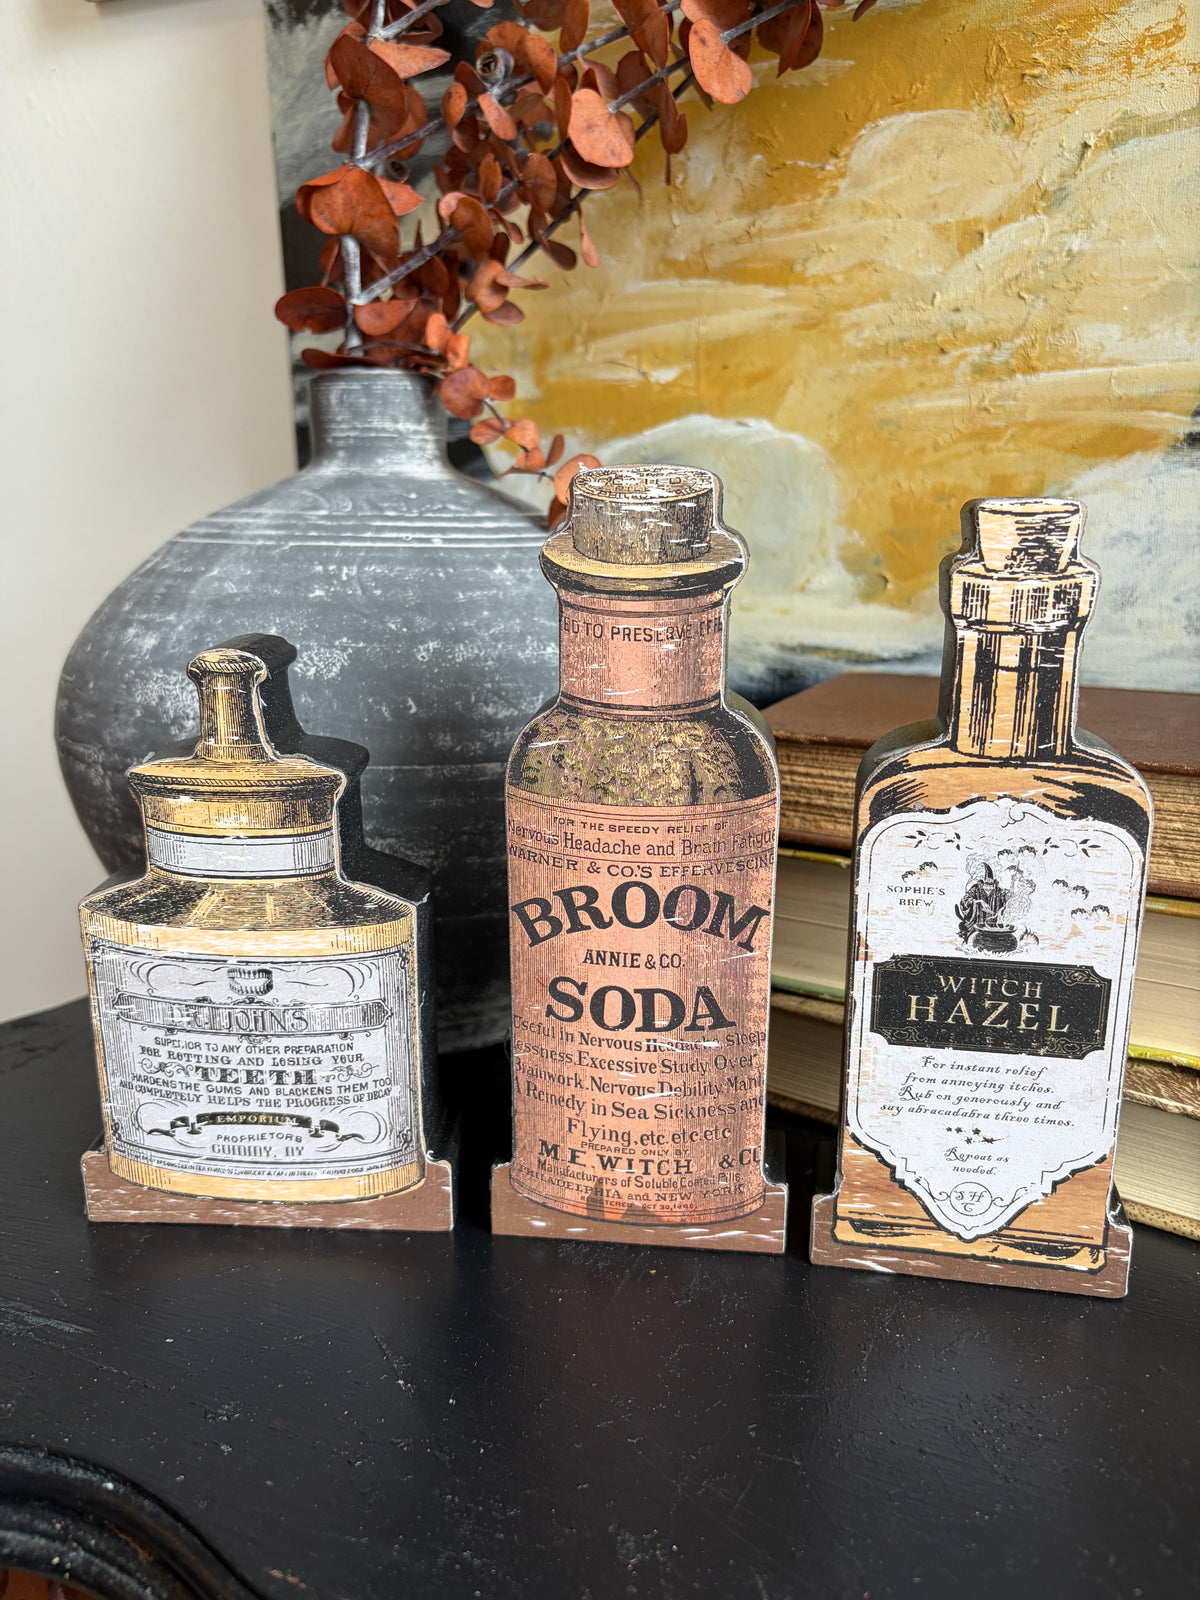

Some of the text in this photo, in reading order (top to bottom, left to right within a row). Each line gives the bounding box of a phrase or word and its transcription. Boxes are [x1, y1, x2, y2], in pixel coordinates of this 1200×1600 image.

[582, 622, 603, 639] TO
[611, 624, 693, 642] PRESERVE
[553, 817, 728, 834] FOR THE SPEEDY RELIEF OF
[507, 819, 559, 845] Nervous
[563, 831, 640, 856] Headache
[646, 840, 675, 856] and
[682, 839, 726, 856] Brain
[508, 844, 578, 871] WARNER
[586, 861, 601, 874] &
[886, 885, 946, 896] SOPHIE'S
[898, 898, 934, 907] BREW
[511, 880, 770, 953] BROOM
[582, 949, 685, 969] ANNIE & CO.
[938, 975, 1043, 1000] WITCH
[545, 976, 736, 1033] SODA
[907, 994, 1070, 1033] HAZEL
[514, 1014, 556, 1039] Useful
[559, 1026, 574, 1042] in
[578, 1031, 642, 1052] Nervous
[139, 1045, 365, 1067] FOR ROTTING AND LOSING YOUR
[221, 1044, 241, 1054] ANY
[245, 1045, 280, 1055] OTHER
[284, 1042, 354, 1055] PREPARATION
[577, 1050, 657, 1075] Excessive
[922, 1055, 1048, 1081] For instant relief
[131, 1072, 392, 1097] HARDENS THE GUMS AND BLACKENS THEM TOO
[194, 1065, 318, 1086] TEETH
[590, 1076, 655, 1097] Nervous
[903, 1072, 1055, 1095] from annoying itches.
[119, 1079, 393, 1108] AND COMPLETELY HELPS THE PROGRESS OF DECAY
[526, 1079, 587, 1117] Remedy
[591, 1098, 607, 1116] in
[611, 1101, 649, 1120] Sea
[654, 1103, 737, 1120] Sickness
[898, 1084, 1065, 1112] Rub on generously and
[216, 1114, 299, 1125] EMPORIUM
[880, 1104, 1075, 1127] say abracadabra three times.
[216, 1131, 303, 1143] PROPRIETORS
[580, 1140, 689, 1157] PREPARED ONLY BY
[597, 1152, 694, 1176] WITCH
[718, 1154, 736, 1170] &
[944, 1146, 1010, 1163] Repeat as
[537, 1157, 618, 1187] Manufacturers
[621, 1176, 632, 1188] of
[634, 1175, 678, 1189] Soluble
[952, 1164, 998, 1176] needed.
[520, 1164, 744, 1202] PHILADELPHIA and NEW YORK
